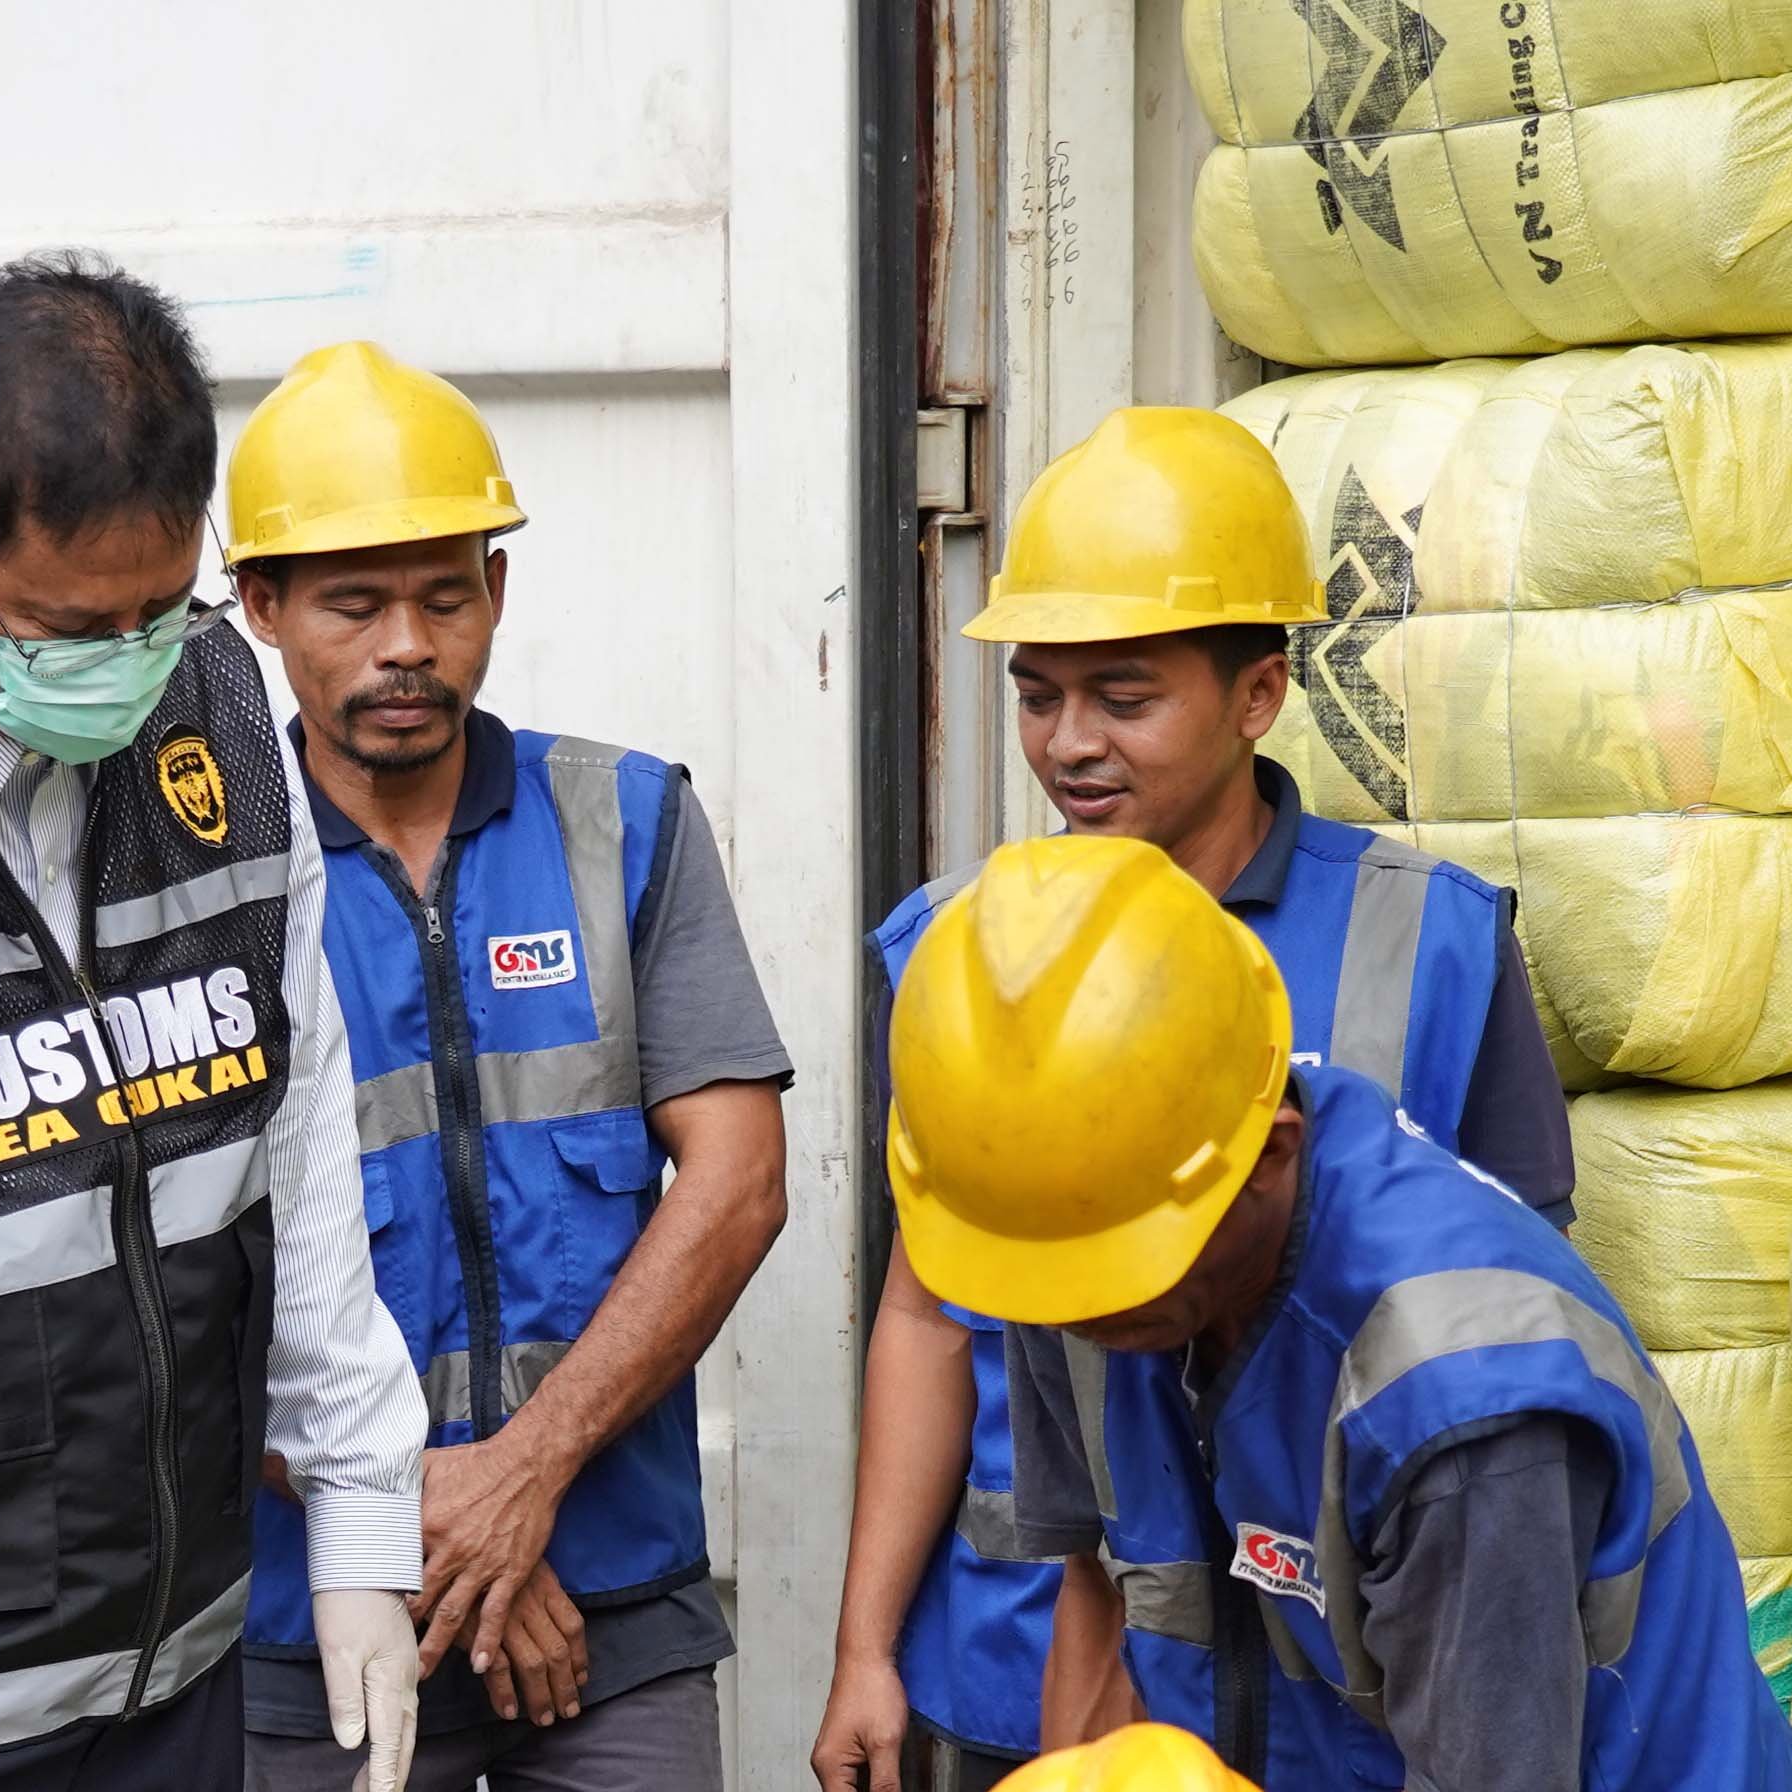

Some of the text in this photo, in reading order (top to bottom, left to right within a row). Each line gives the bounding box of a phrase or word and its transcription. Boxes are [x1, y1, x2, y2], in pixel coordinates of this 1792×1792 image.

[1508, 34, 1542, 188] Trading
[495, 938, 565, 973] GMS
[96, 1046, 269, 1126] CUKAI
